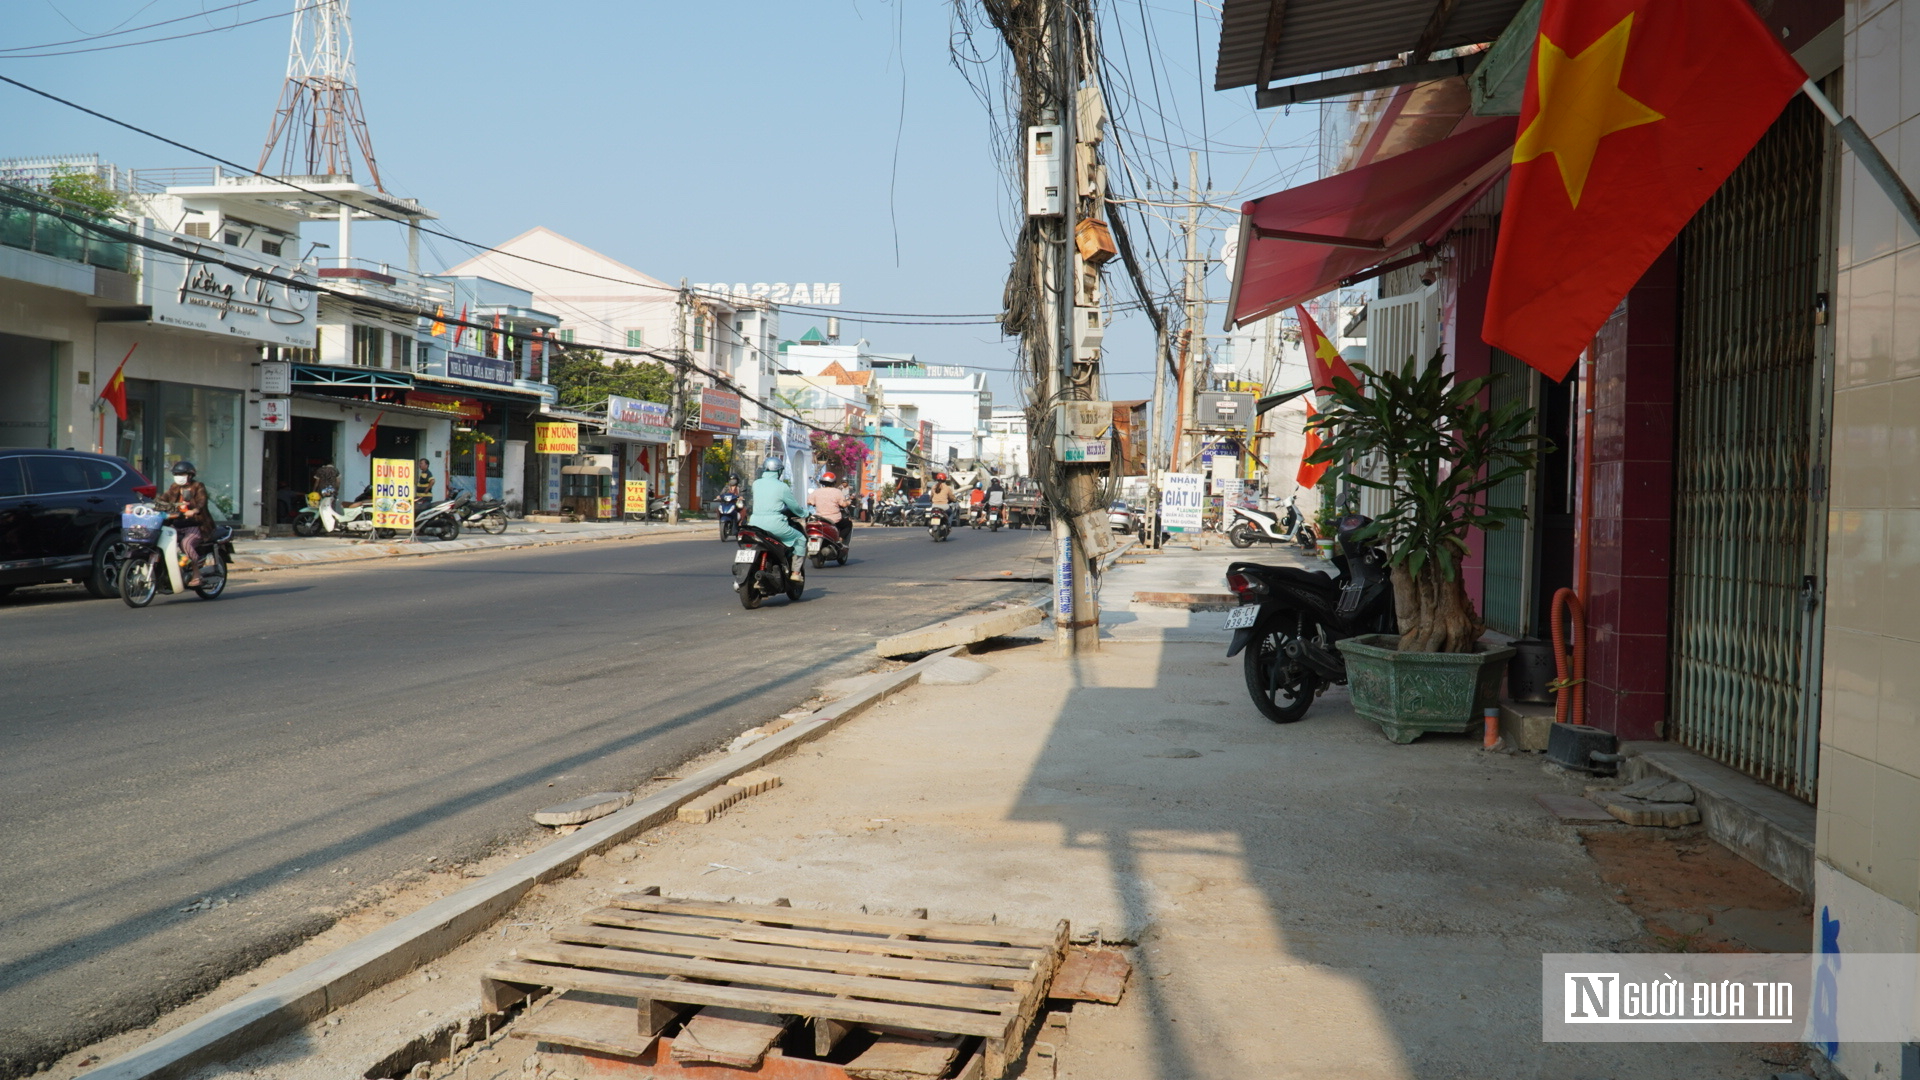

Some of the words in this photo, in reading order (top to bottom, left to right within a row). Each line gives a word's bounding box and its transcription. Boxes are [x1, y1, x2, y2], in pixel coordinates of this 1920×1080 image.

[450, 360, 462, 375] NHÀ
[485, 368, 496, 380] KHU
[927, 365, 942, 376] THU
[537, 427, 550, 441] VỊT
[551, 424, 577, 439] NƯỚNG
[377, 462, 395, 478] BÚN
[398, 463, 410, 478] BÒ
[1170, 475, 1198, 486] NHẬN
[398, 482, 410, 497] BÒ
[627, 486, 645, 494] VỊT
[1191, 486, 1201, 507] ỦI
[376, 513, 410, 526] 376
[1232, 606, 1255, 618] 86-C1
